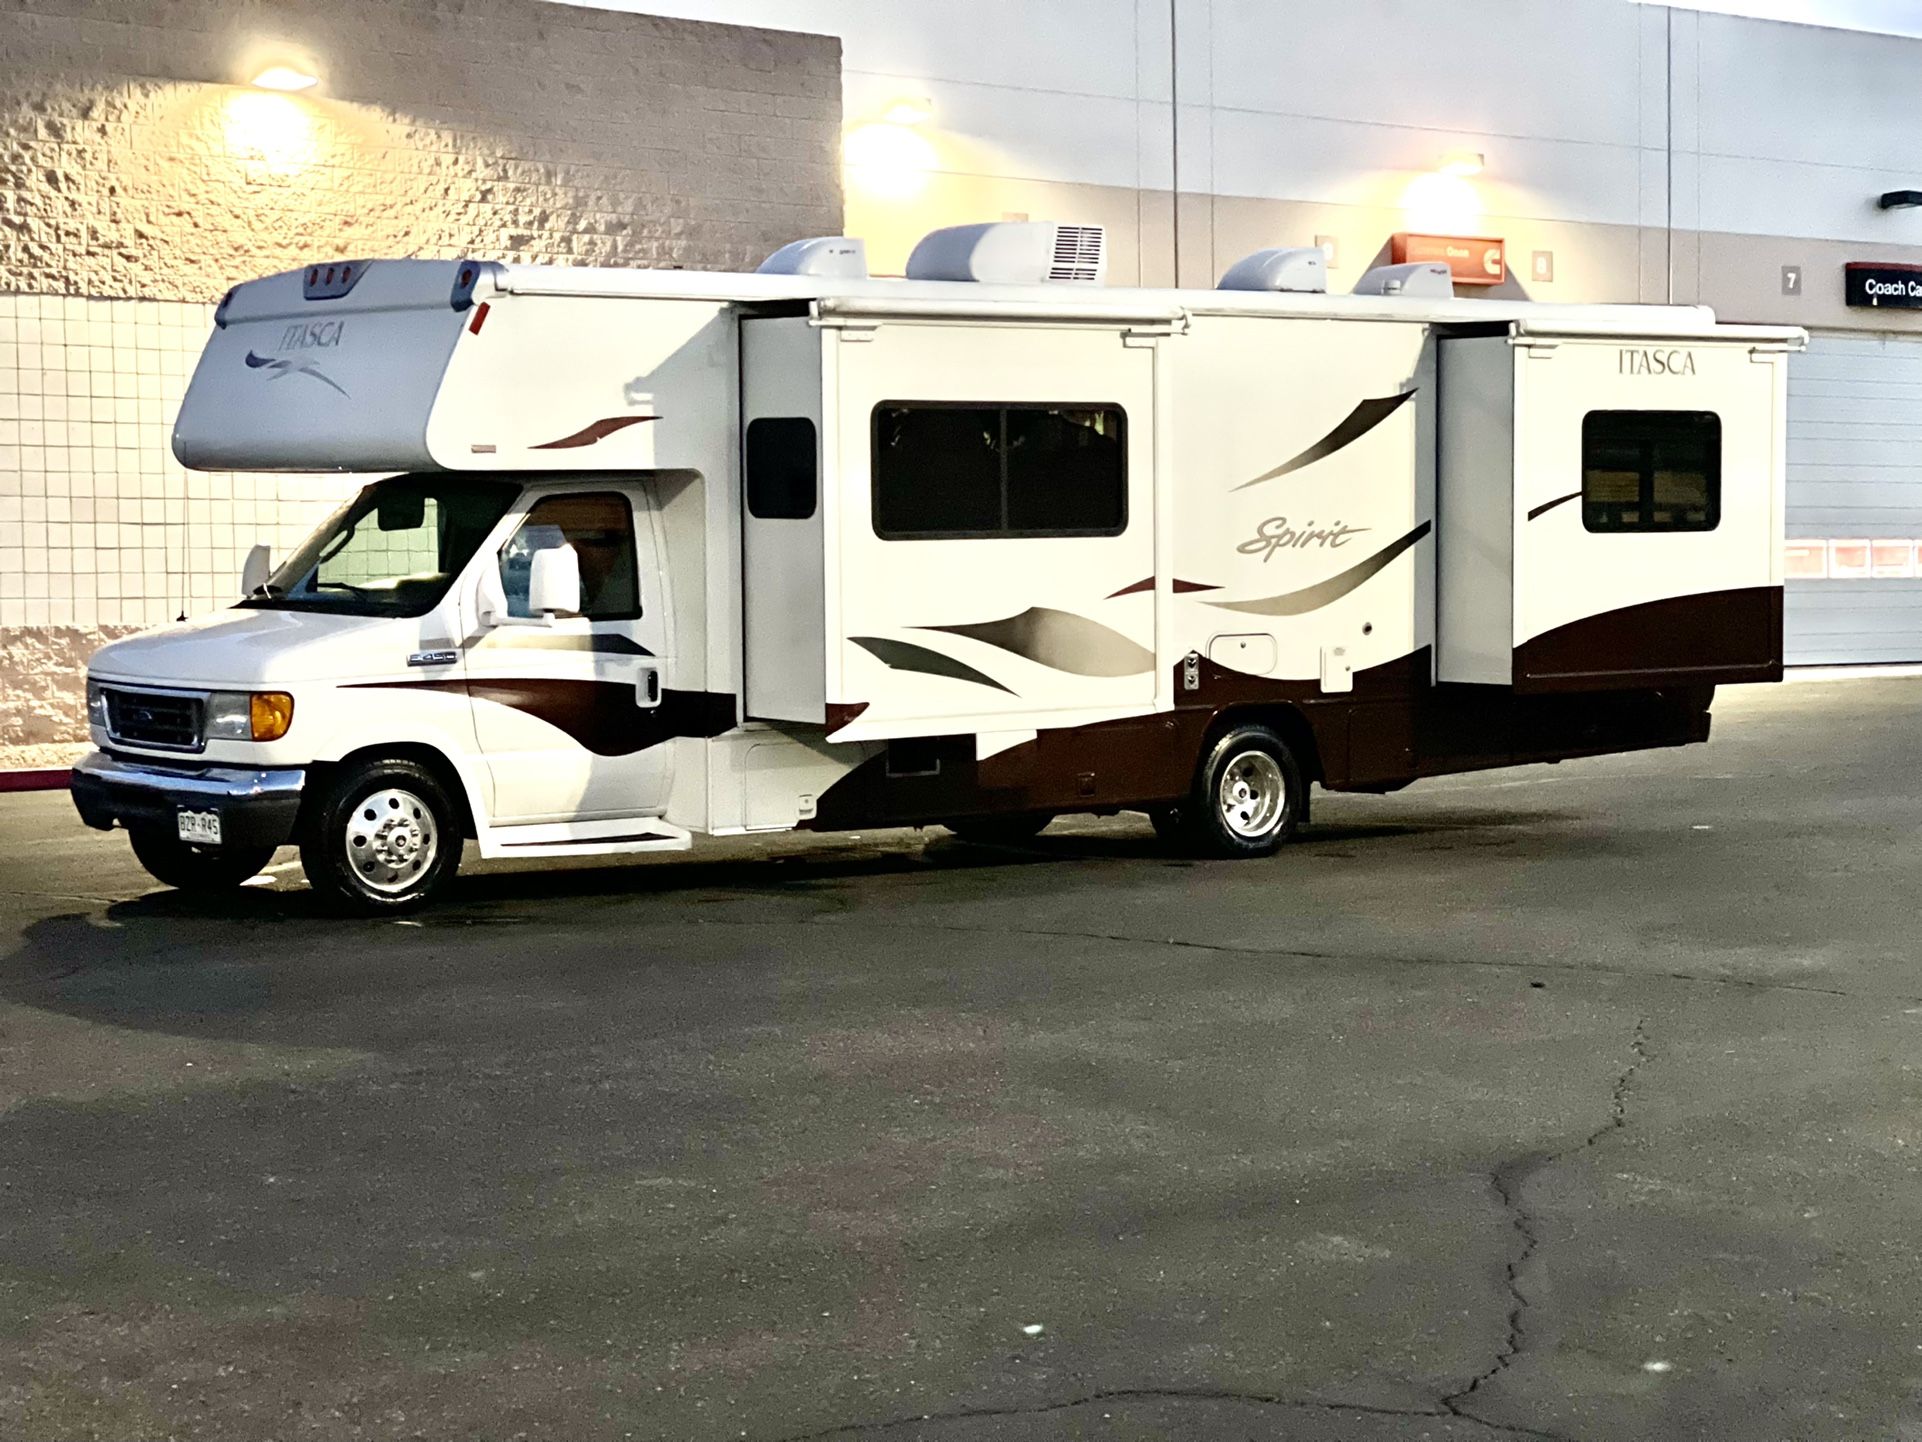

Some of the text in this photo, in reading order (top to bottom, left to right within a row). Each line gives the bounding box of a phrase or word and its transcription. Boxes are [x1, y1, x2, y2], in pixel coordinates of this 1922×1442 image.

[1787, 272, 1797, 289] 7
[1865, 278, 1906, 296] Coach
[278, 321, 345, 351] ITASCA
[1618, 348, 1697, 376] ITASCA
[1236, 516, 1373, 564] Spirit
